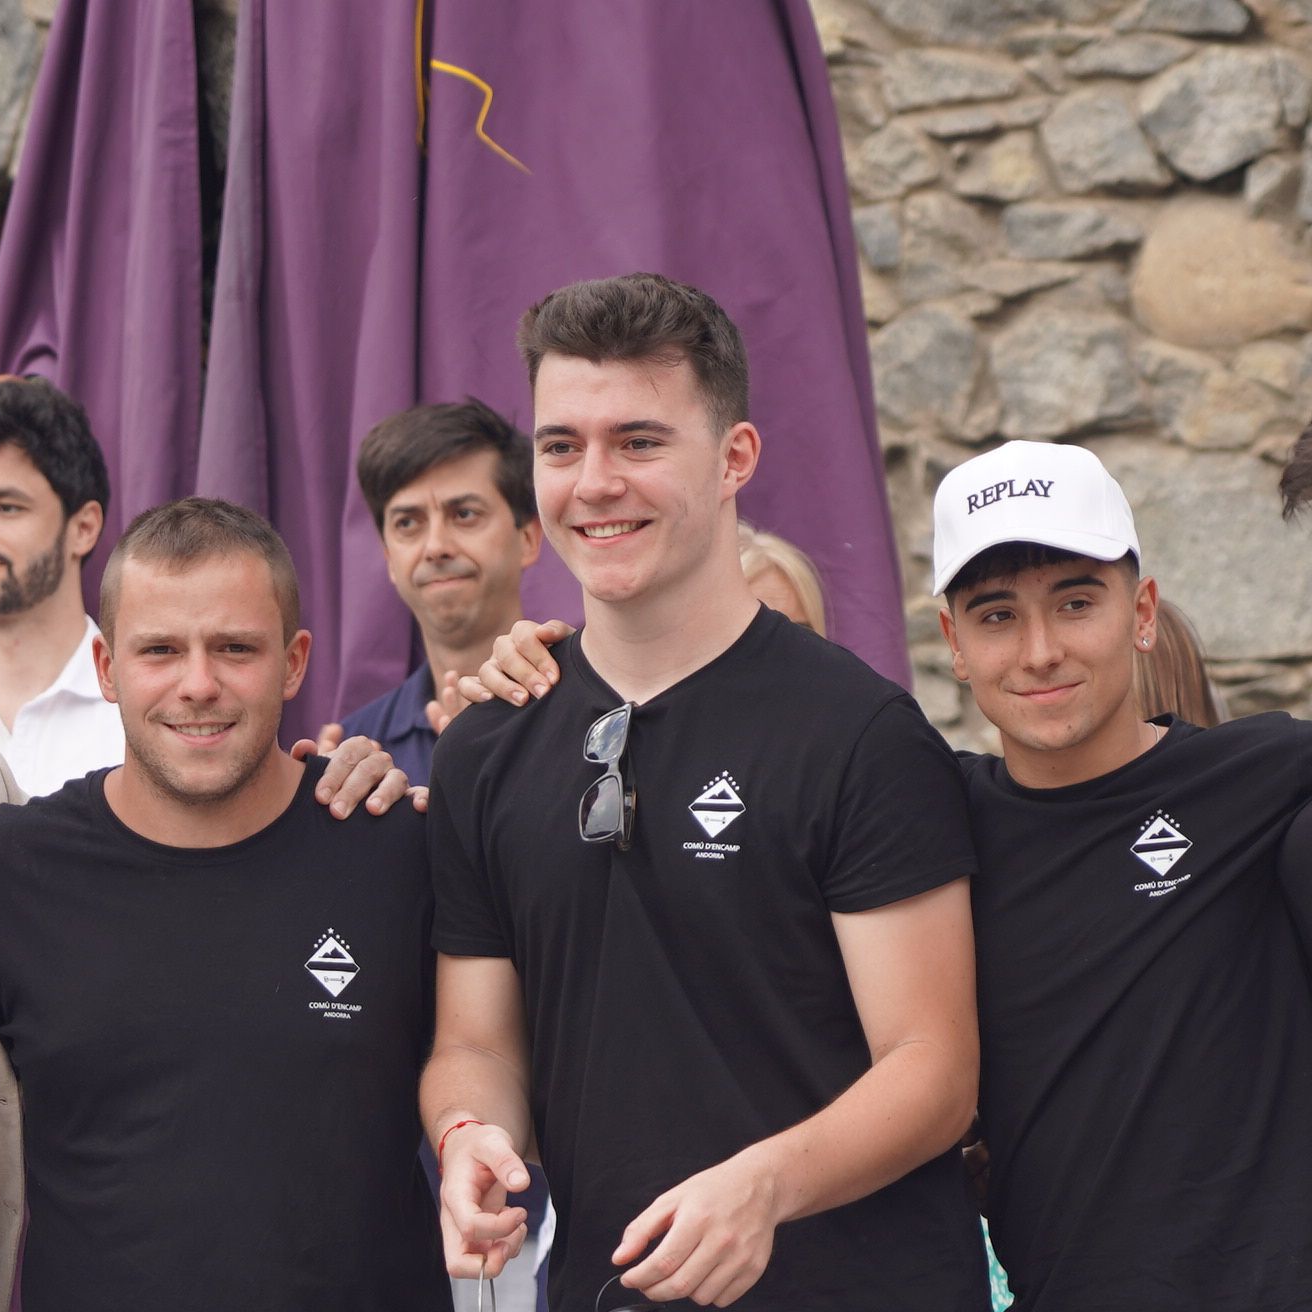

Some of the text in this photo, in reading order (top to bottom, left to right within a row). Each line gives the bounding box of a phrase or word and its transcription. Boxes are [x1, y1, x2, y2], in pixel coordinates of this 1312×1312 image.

[966, 478, 1055, 515] REPLAY
[683, 841, 740, 852] COMÚ D'ENCAMP
[309, 1001, 361, 1012] COMÚ D'ENCAMP
[324, 1011, 351, 1019] ANDORRA
